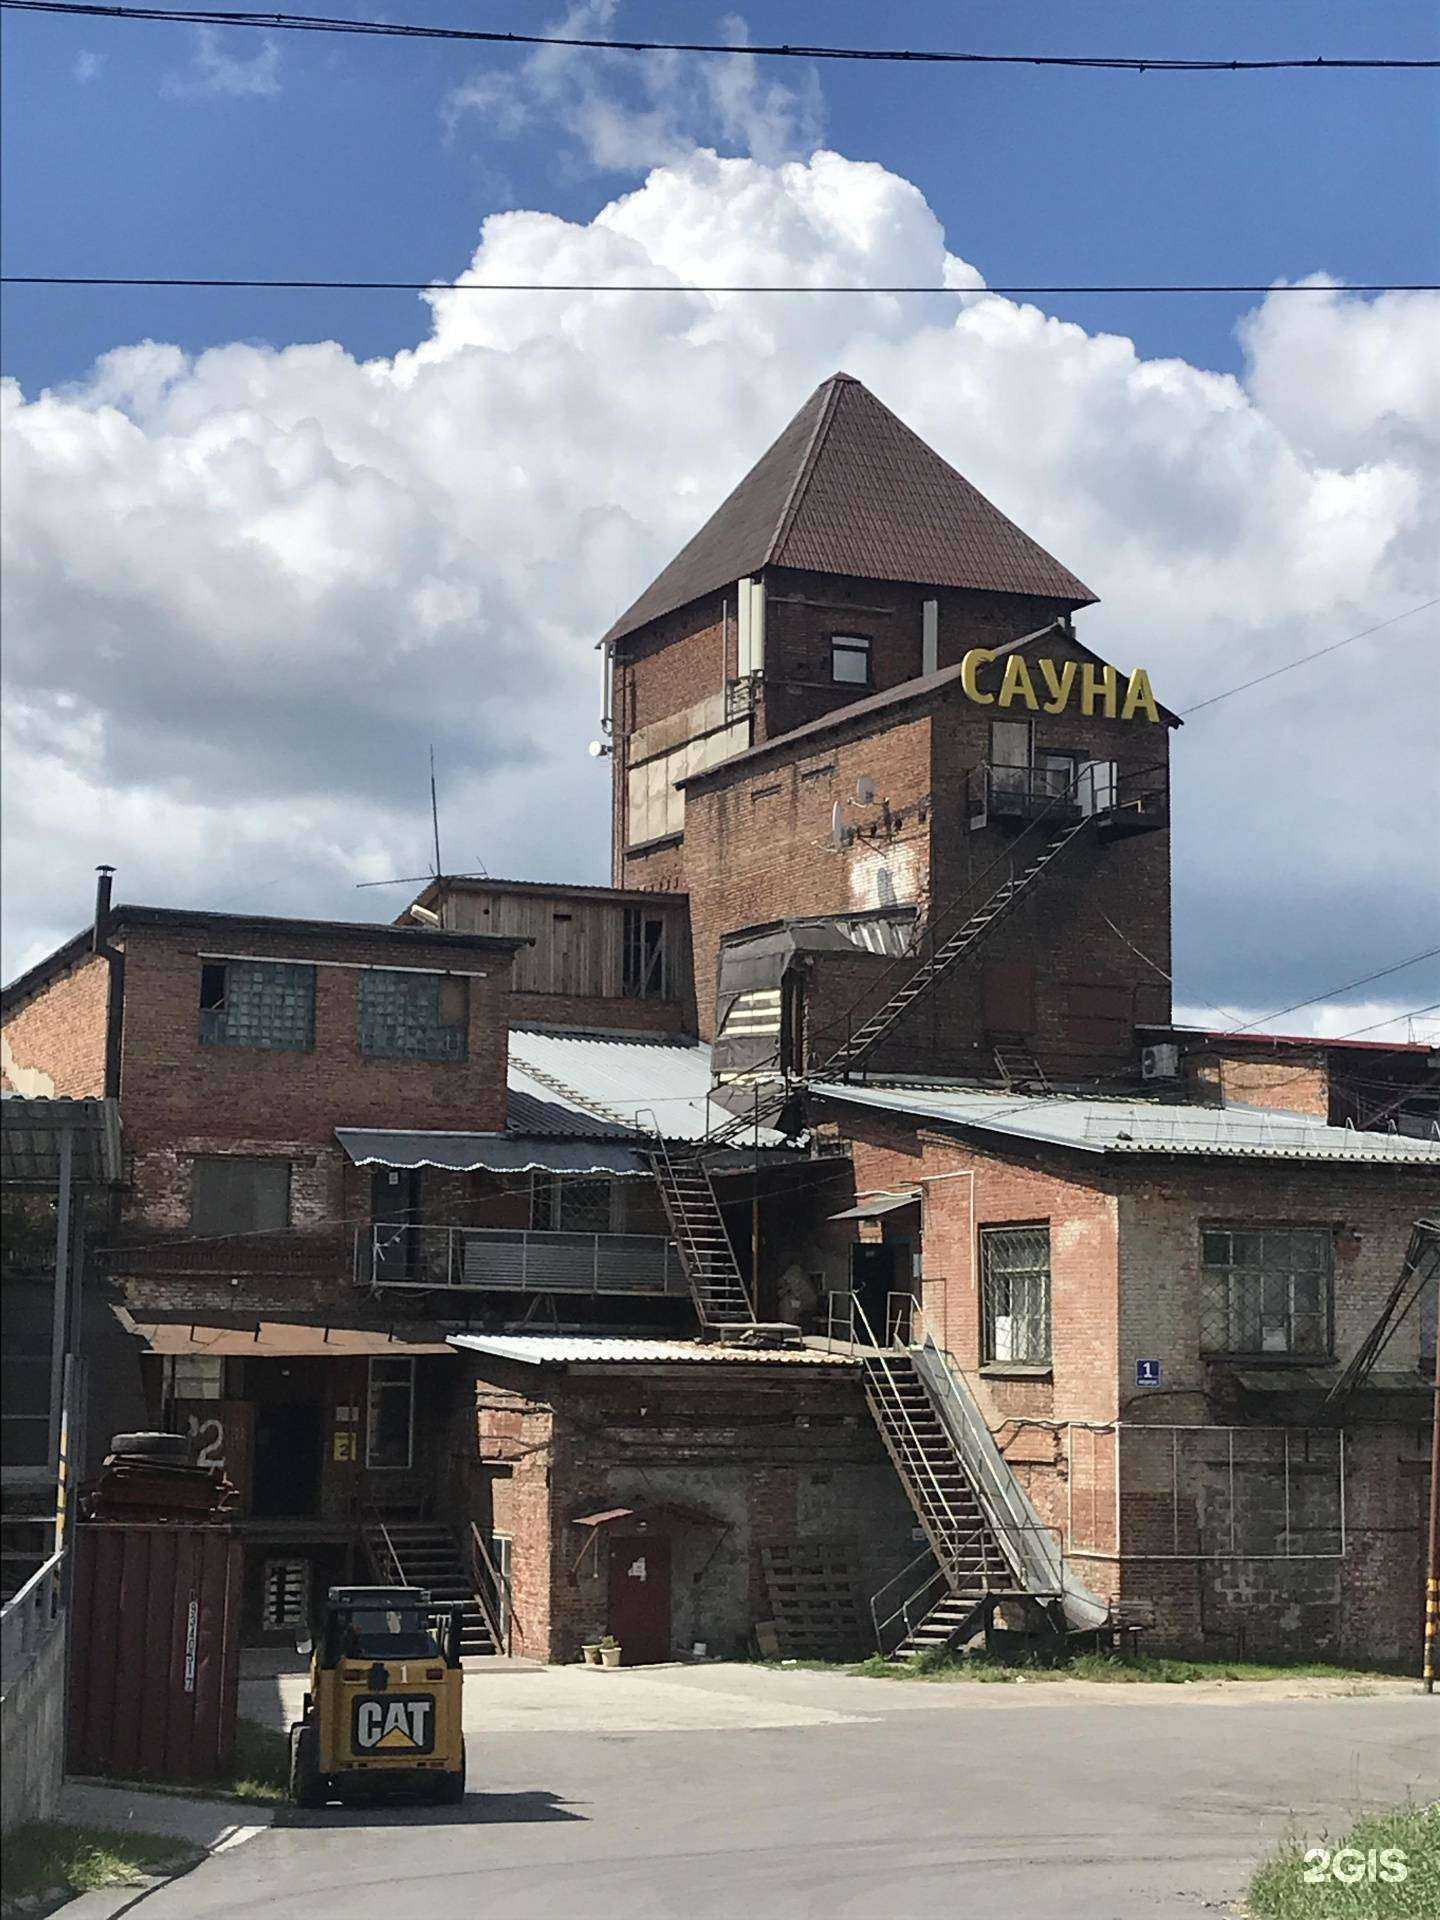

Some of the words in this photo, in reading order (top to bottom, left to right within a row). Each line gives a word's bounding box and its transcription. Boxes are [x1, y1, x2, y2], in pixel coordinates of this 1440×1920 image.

[961, 648, 1160, 723] САУНА
[1142, 1362, 1152, 1378] 1
[358, 1702, 431, 1748] CAT
